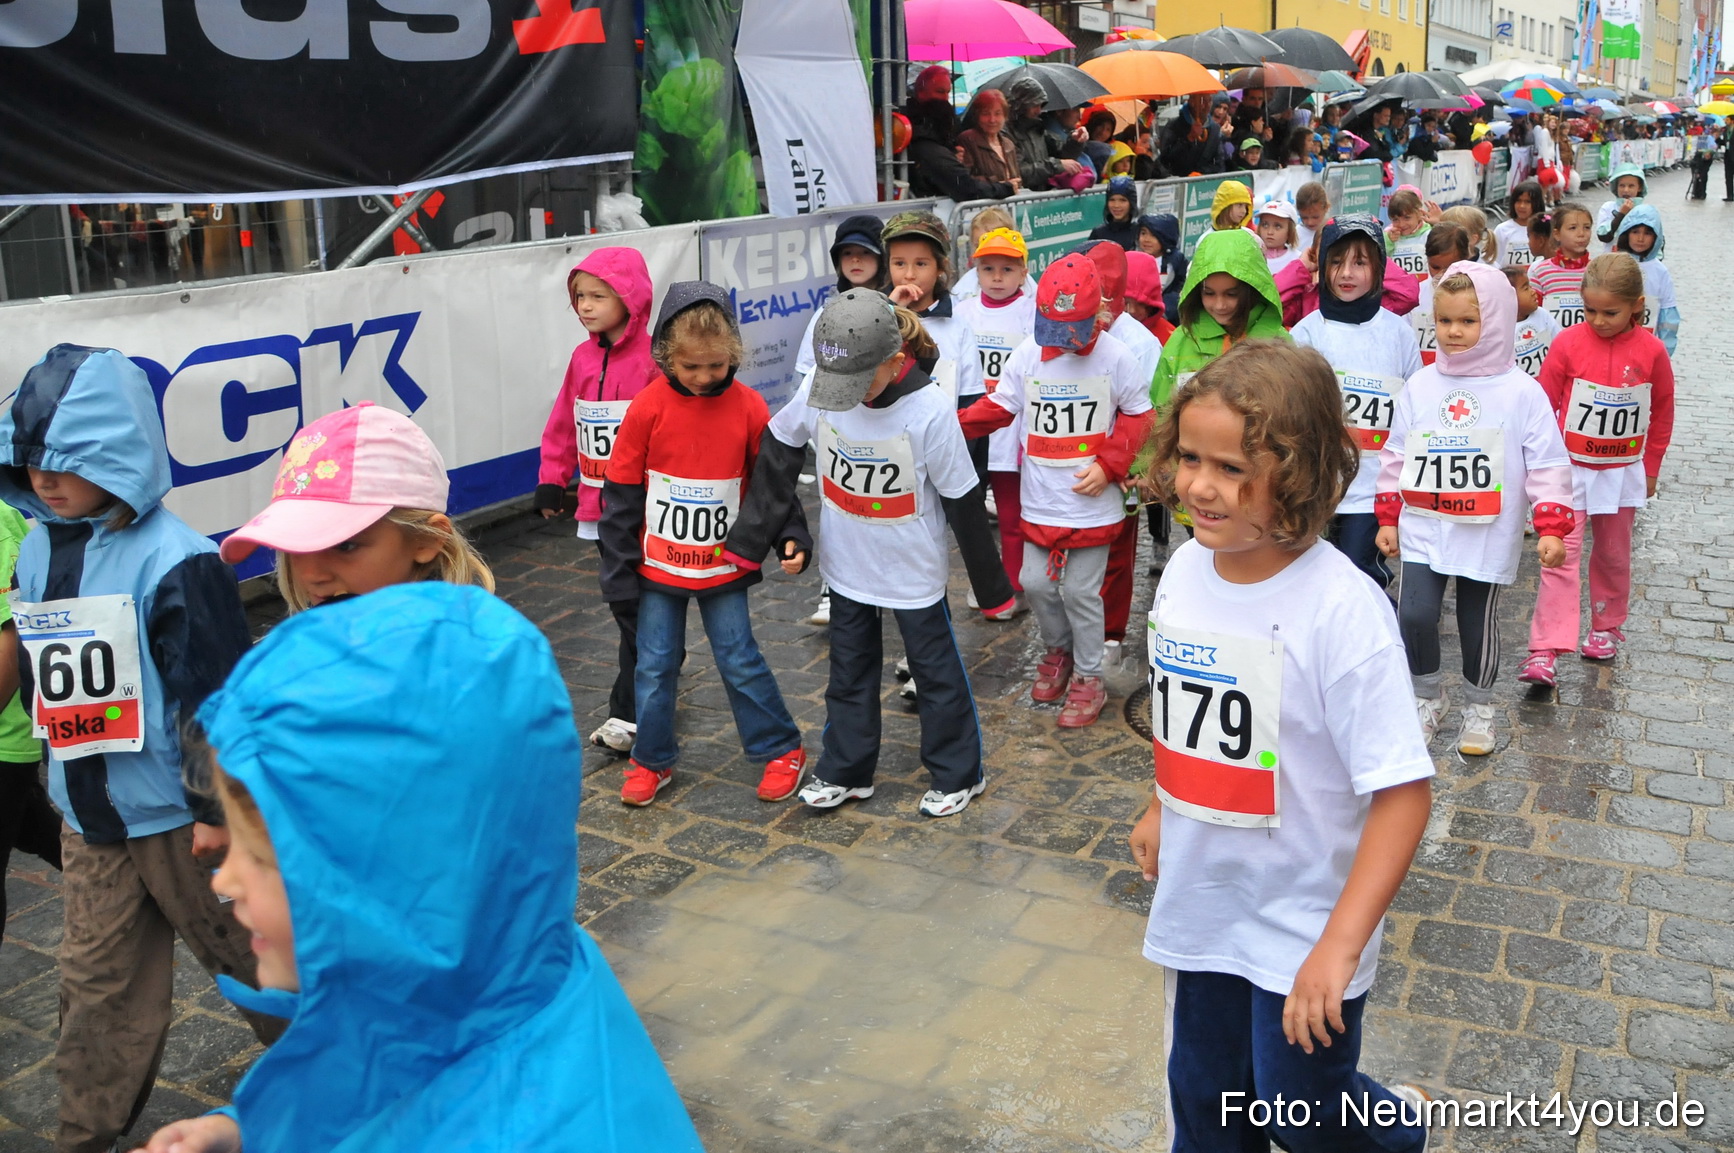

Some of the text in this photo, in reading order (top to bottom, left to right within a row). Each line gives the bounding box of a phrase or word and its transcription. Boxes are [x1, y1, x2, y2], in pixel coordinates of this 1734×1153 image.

[1039, 384, 1078, 395] BOCK
[1344, 376, 1382, 389] BOCK
[1444, 390, 1479, 410] DEUTSCHES
[1594, 390, 1632, 402] BOCK
[1031, 401, 1098, 434] 7317
[1344, 393, 1394, 428] 241
[1441, 407, 1478, 430] ROTES KREUZ
[1578, 402, 1640, 437] 7101
[1428, 435, 1469, 447] BOCK
[1585, 440, 1628, 456] Svenja
[827, 446, 902, 494] 7272
[1413, 454, 1491, 490] 7156
[670, 484, 714, 498] BOCK
[656, 499, 728, 543] 7008
[666, 545, 714, 568] Sophia
[1155, 633, 1217, 667] BOCK
[39, 640, 134, 702] 60 W
